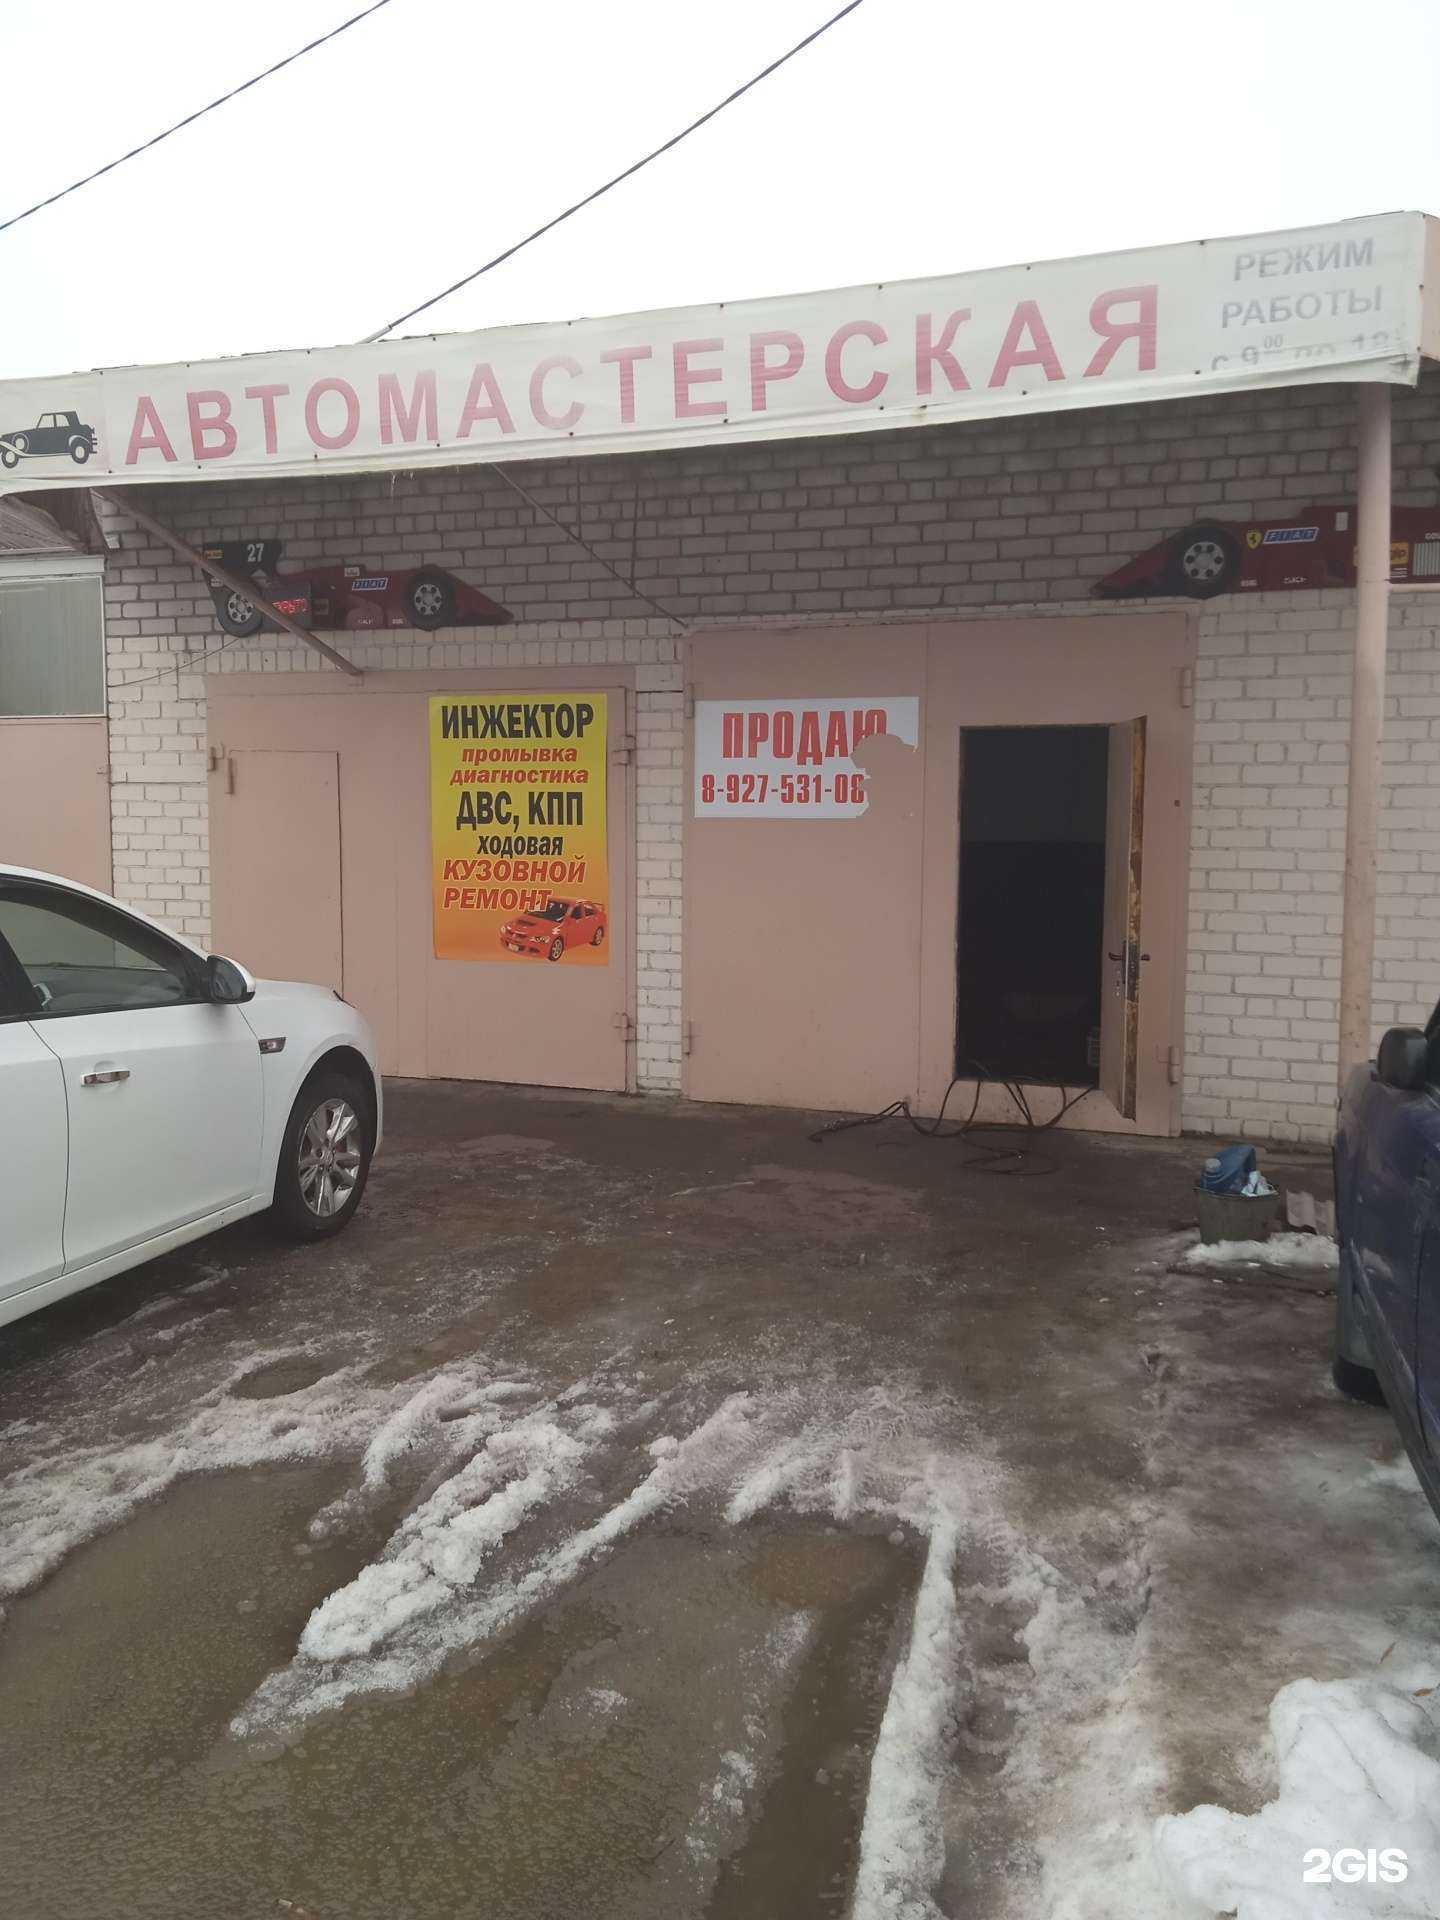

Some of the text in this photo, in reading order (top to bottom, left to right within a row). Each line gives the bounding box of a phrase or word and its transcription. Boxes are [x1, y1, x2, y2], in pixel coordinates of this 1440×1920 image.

[1233, 237, 1374, 281] РЕЖИМ
[1221, 285, 1382, 328] РАБОТЫ
[124, 284, 1158, 465] АВТОМАСТЕРСКАЯ
[247, 543, 265, 562] 27
[441, 703, 594, 739] ИНЖЕКТОР
[462, 747, 578, 766] промывка
[450, 769, 589, 786] диагностика
[456, 790, 583, 832] ДВС, КПП
[443, 855, 587, 884] КУЗОВНОЙ
[443, 887, 553, 912] РЕМОНТ
